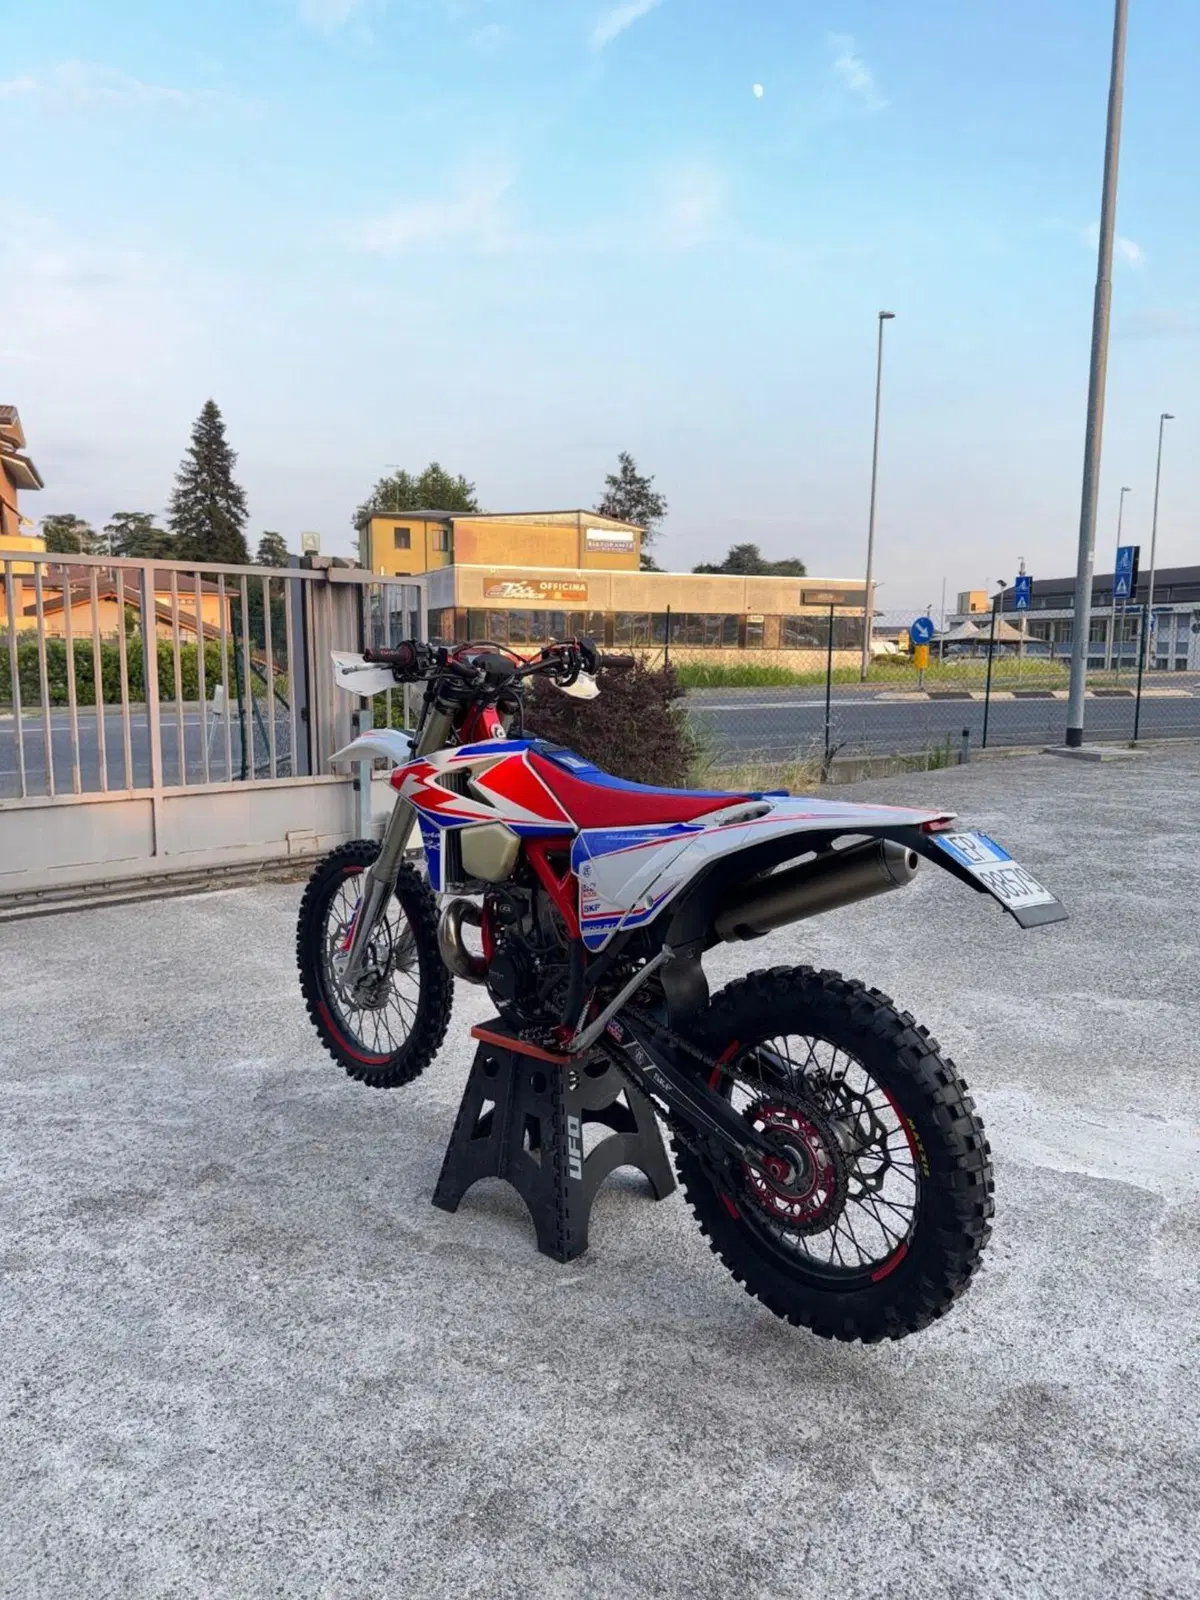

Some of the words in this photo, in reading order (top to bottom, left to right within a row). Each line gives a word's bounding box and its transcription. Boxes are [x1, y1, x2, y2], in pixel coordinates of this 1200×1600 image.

[540, 582, 586, 592] OFFICINA
[947, 836, 986, 861] EP
[980, 868, 1045, 899] 88579
[583, 903, 601, 913] SKF
[567, 1114, 582, 1180] UFO
[906, 1117, 931, 1177] MAXXIS
